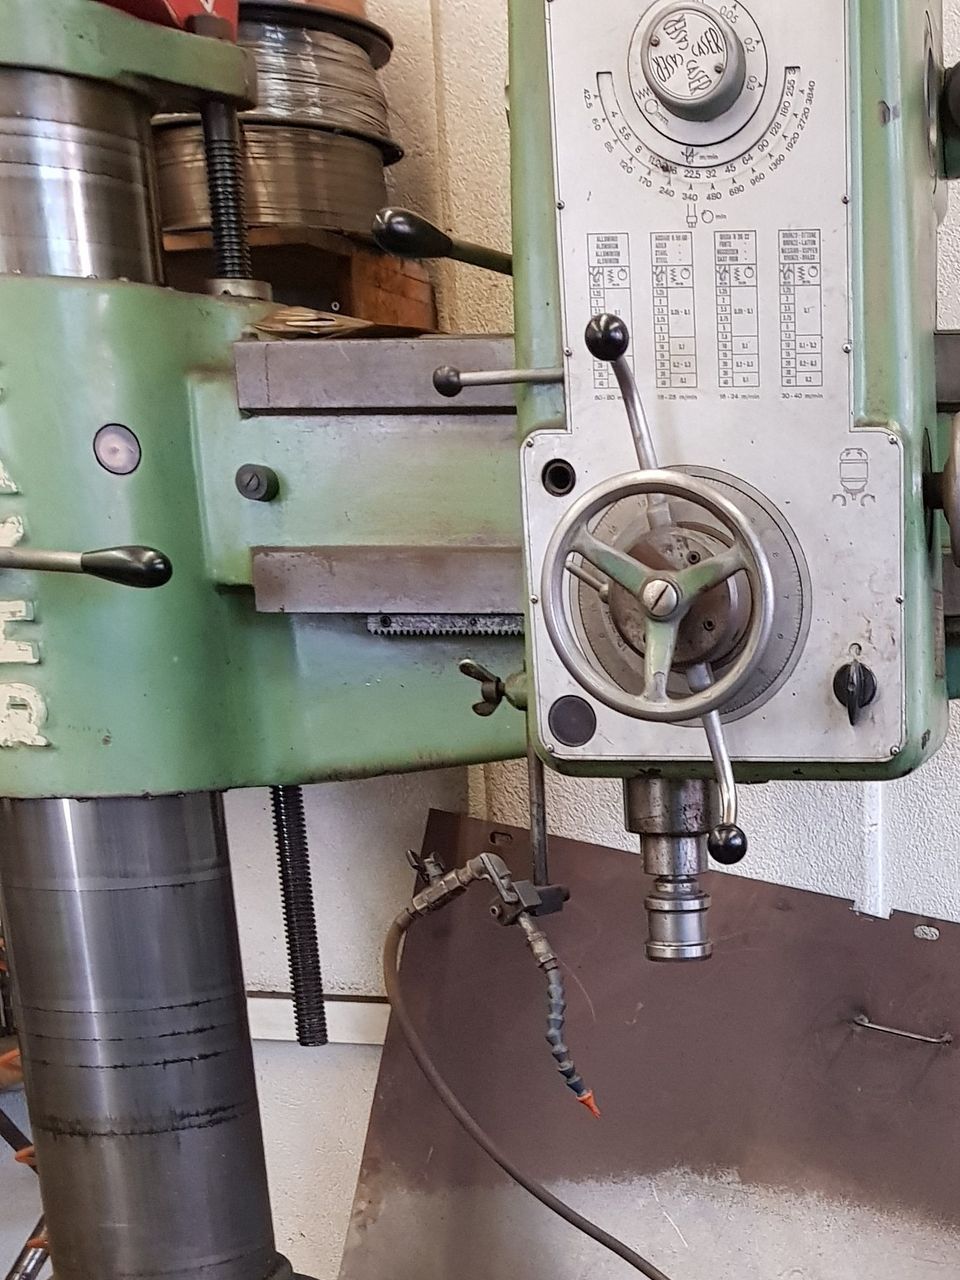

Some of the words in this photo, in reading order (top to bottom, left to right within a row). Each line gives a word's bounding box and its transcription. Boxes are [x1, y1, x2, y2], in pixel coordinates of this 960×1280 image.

[663, 13, 689, 51] CASER
[691, 27, 724, 57] CASER
[652, 53, 684, 82] CASER
[686, 60, 712, 96] CASER
[786, 79, 796, 97] 255
[805, 80, 816, 106] 3840
[780, 100, 791, 117] 180
[591, 118, 601, 131] 60
[797, 107, 810, 131] 2720
[769, 122, 782, 137] 128
[634, 145, 642, 153] 8
[757, 139, 769, 152] 90
[785, 132, 800, 152] 1920
[741, 153, 753, 165] 64
[768, 154, 785, 172] 1360
[620, 160, 633, 174] 120
[705, 169, 717, 178] 32
[724, 163, 736, 173] 45
[638, 176, 652, 188] 170
[749, 172, 765, 186] 960
[659, 186, 675, 198] 240
[681, 192, 698, 202] 340
[706, 192, 722, 201] 480
[729, 185, 744, 197] 680
